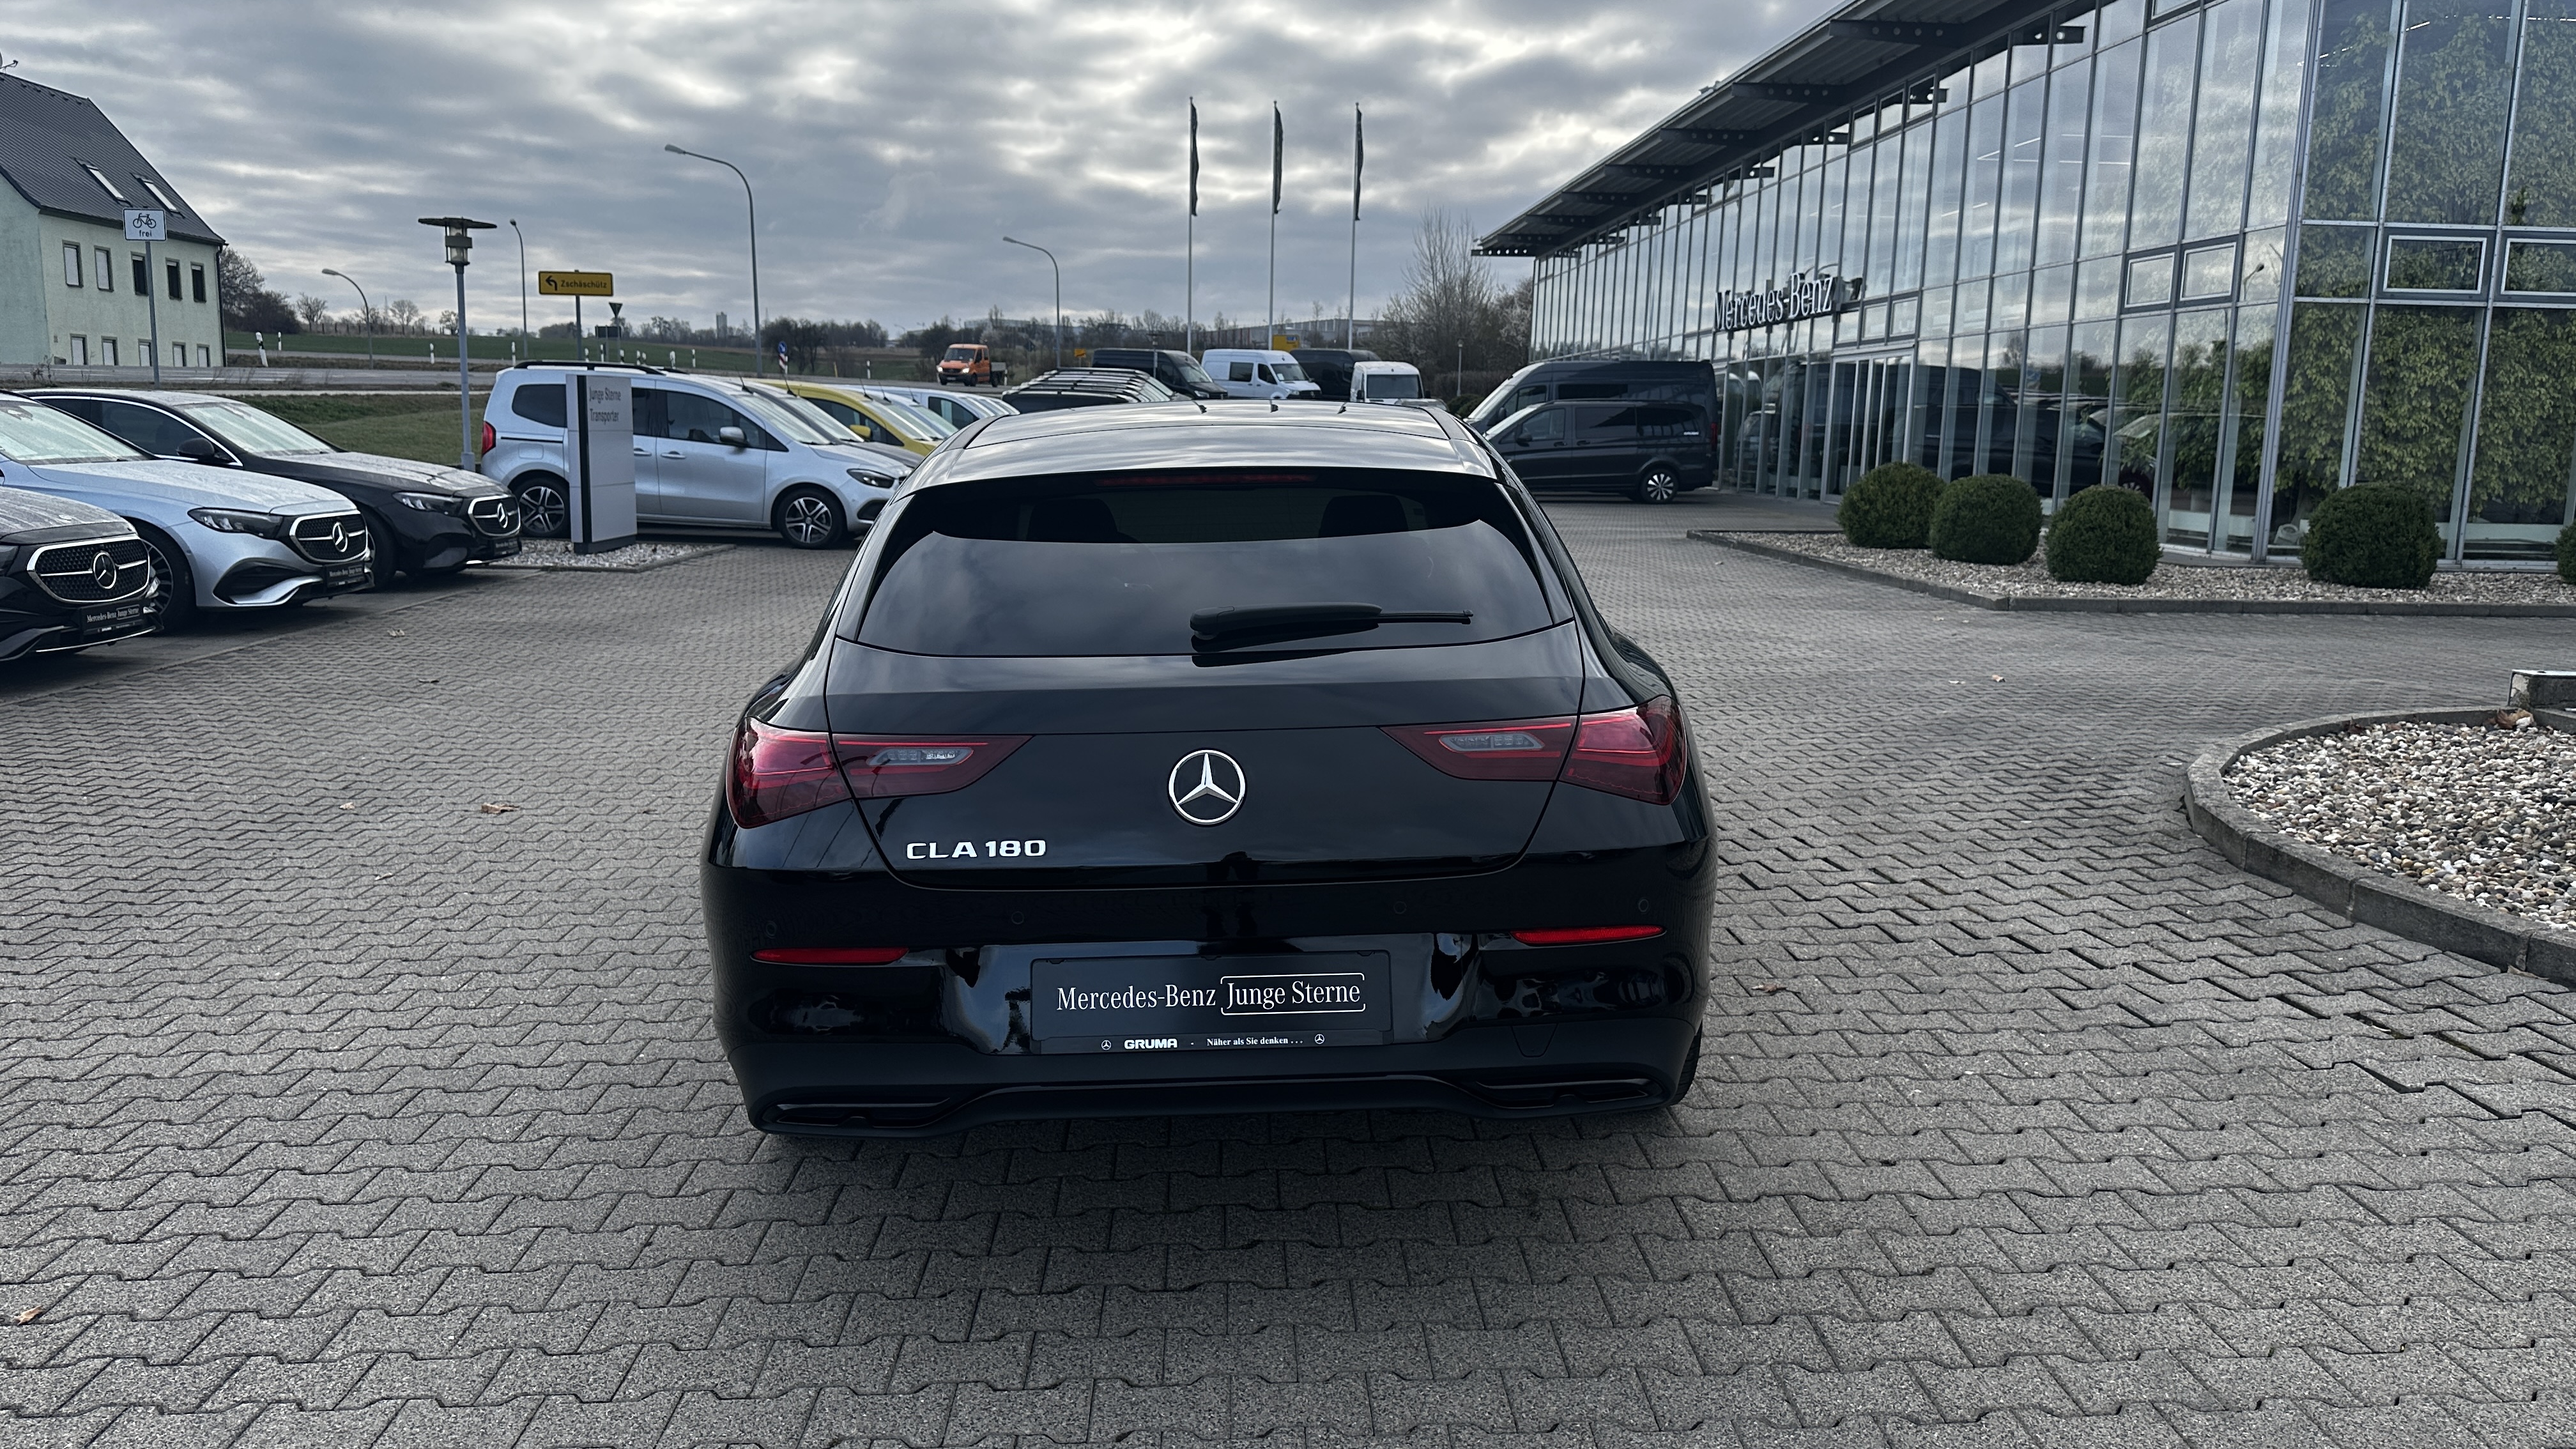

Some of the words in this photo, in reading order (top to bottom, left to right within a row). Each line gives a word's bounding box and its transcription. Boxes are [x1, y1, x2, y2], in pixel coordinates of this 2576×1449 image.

[561, 280, 608, 289] Zschäschütz
[1714, 272, 1833, 331] Mercedes-Benz
[589, 387, 604, 404] Junge
[605, 387, 621, 401] Sterne
[590, 408, 619, 425] Transporter
[907, 841, 977, 859] CLA
[985, 839, 1046, 857] 180
[1056, 984, 1216, 1011] Mercedes-Benz
[1226, 982, 1286, 1009] Junge
[1291, 980, 1361, 1004] Sterne
[1124, 1038, 1177, 1050] GRUMA
[1206, 1038, 1231, 1046] Näher
[1233, 1038, 1245, 1046] als
[1246, 1037, 1258, 1045] Sie
[1260, 1036, 1289, 1045] denken
